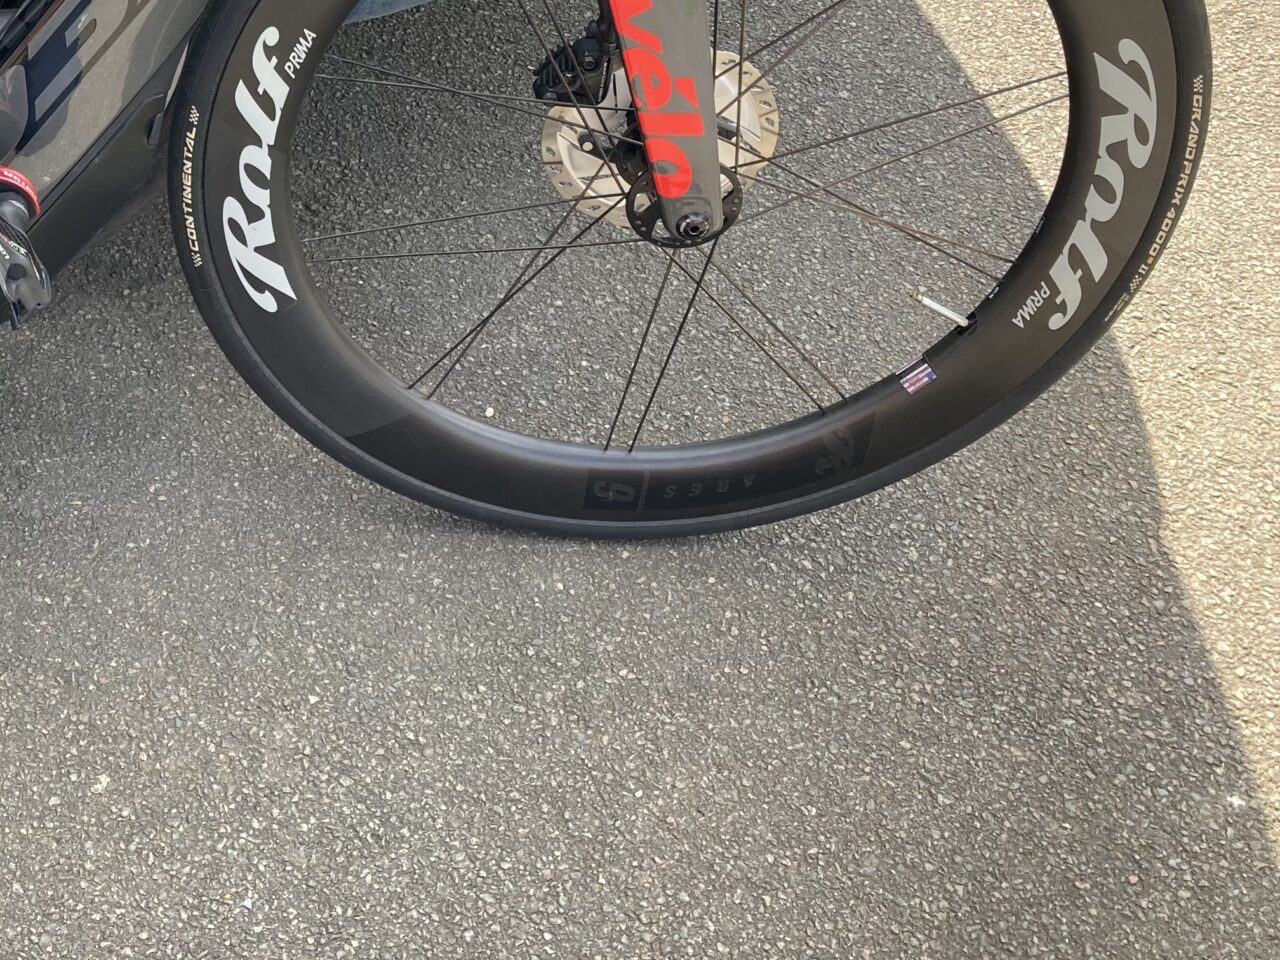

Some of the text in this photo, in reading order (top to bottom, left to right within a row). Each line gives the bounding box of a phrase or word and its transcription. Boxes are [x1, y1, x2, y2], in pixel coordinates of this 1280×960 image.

[181, 128, 197, 253] CONTINENTAL
[222, 26, 316, 313] Rolf PRIMA
[1011, 38, 1158, 331] Rolf PRIMA
